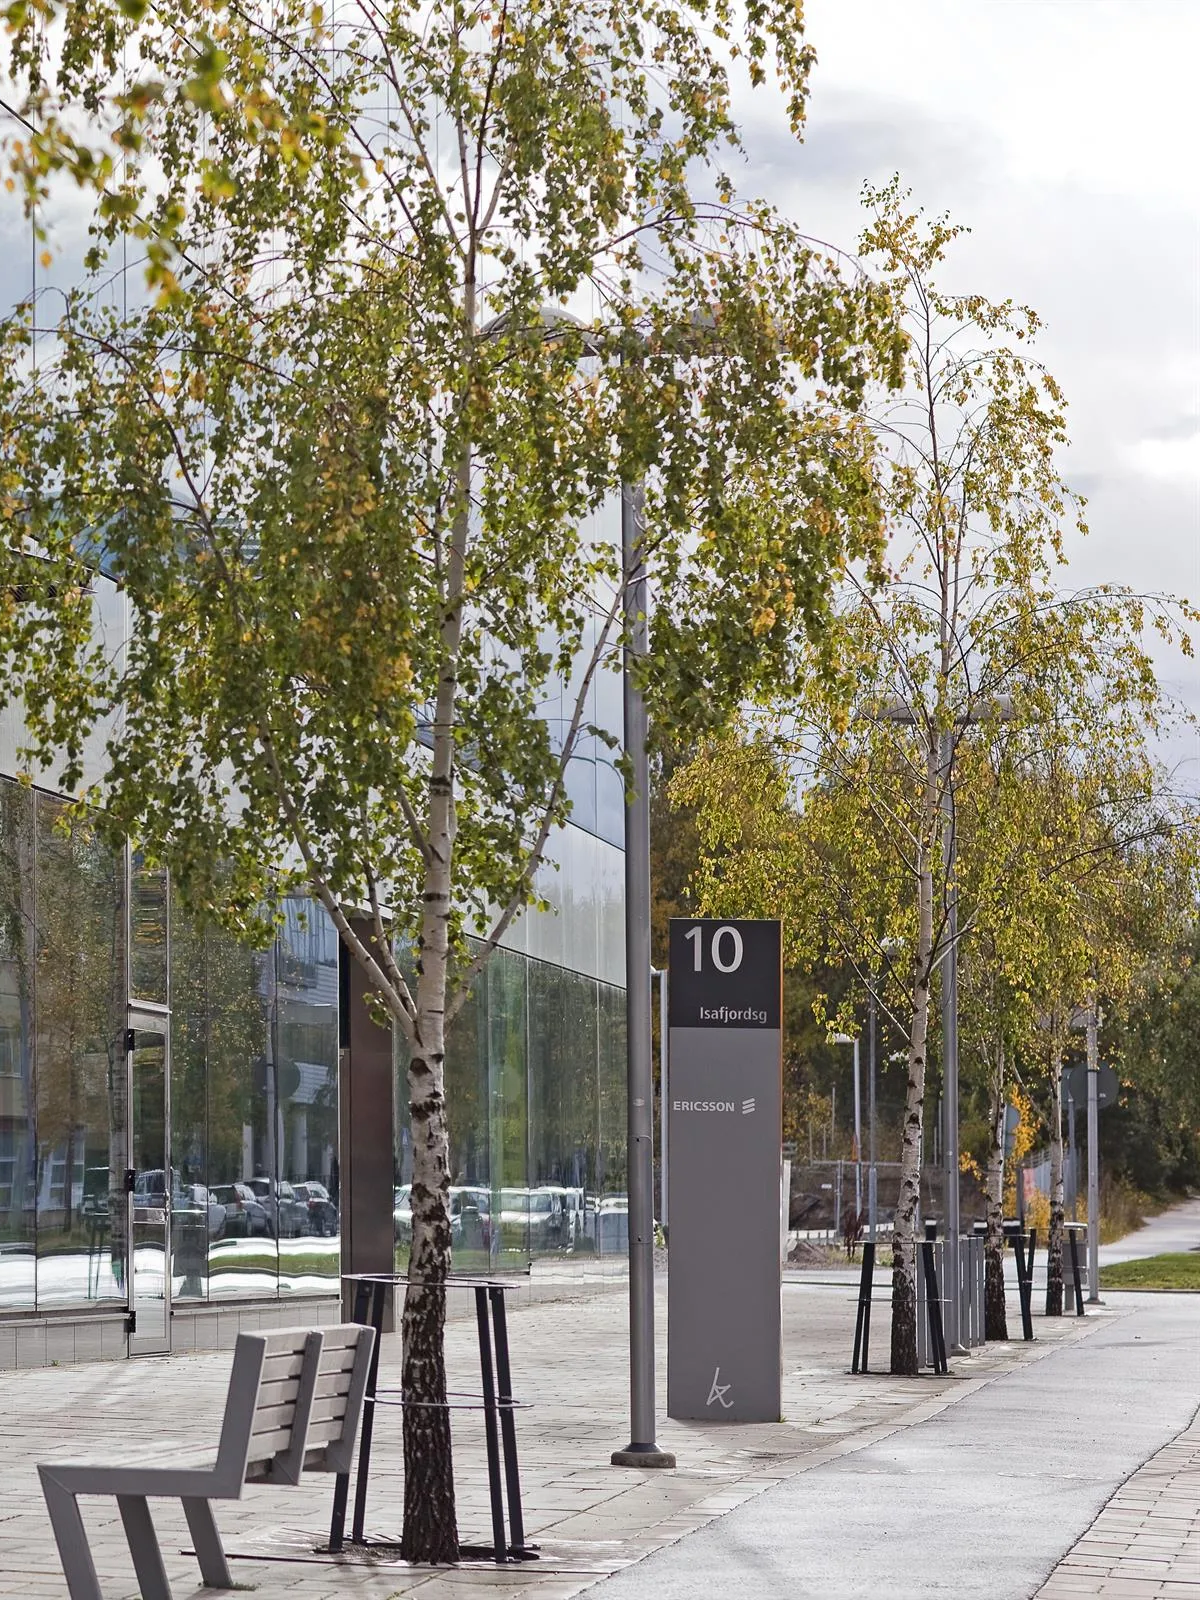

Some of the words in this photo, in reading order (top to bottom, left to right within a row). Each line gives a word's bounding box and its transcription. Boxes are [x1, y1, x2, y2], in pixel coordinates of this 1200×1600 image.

[684, 925, 744, 973] 10
[700, 1006, 767, 1024] Isafjordsg
[673, 1101, 735, 1112] ERICSSON
